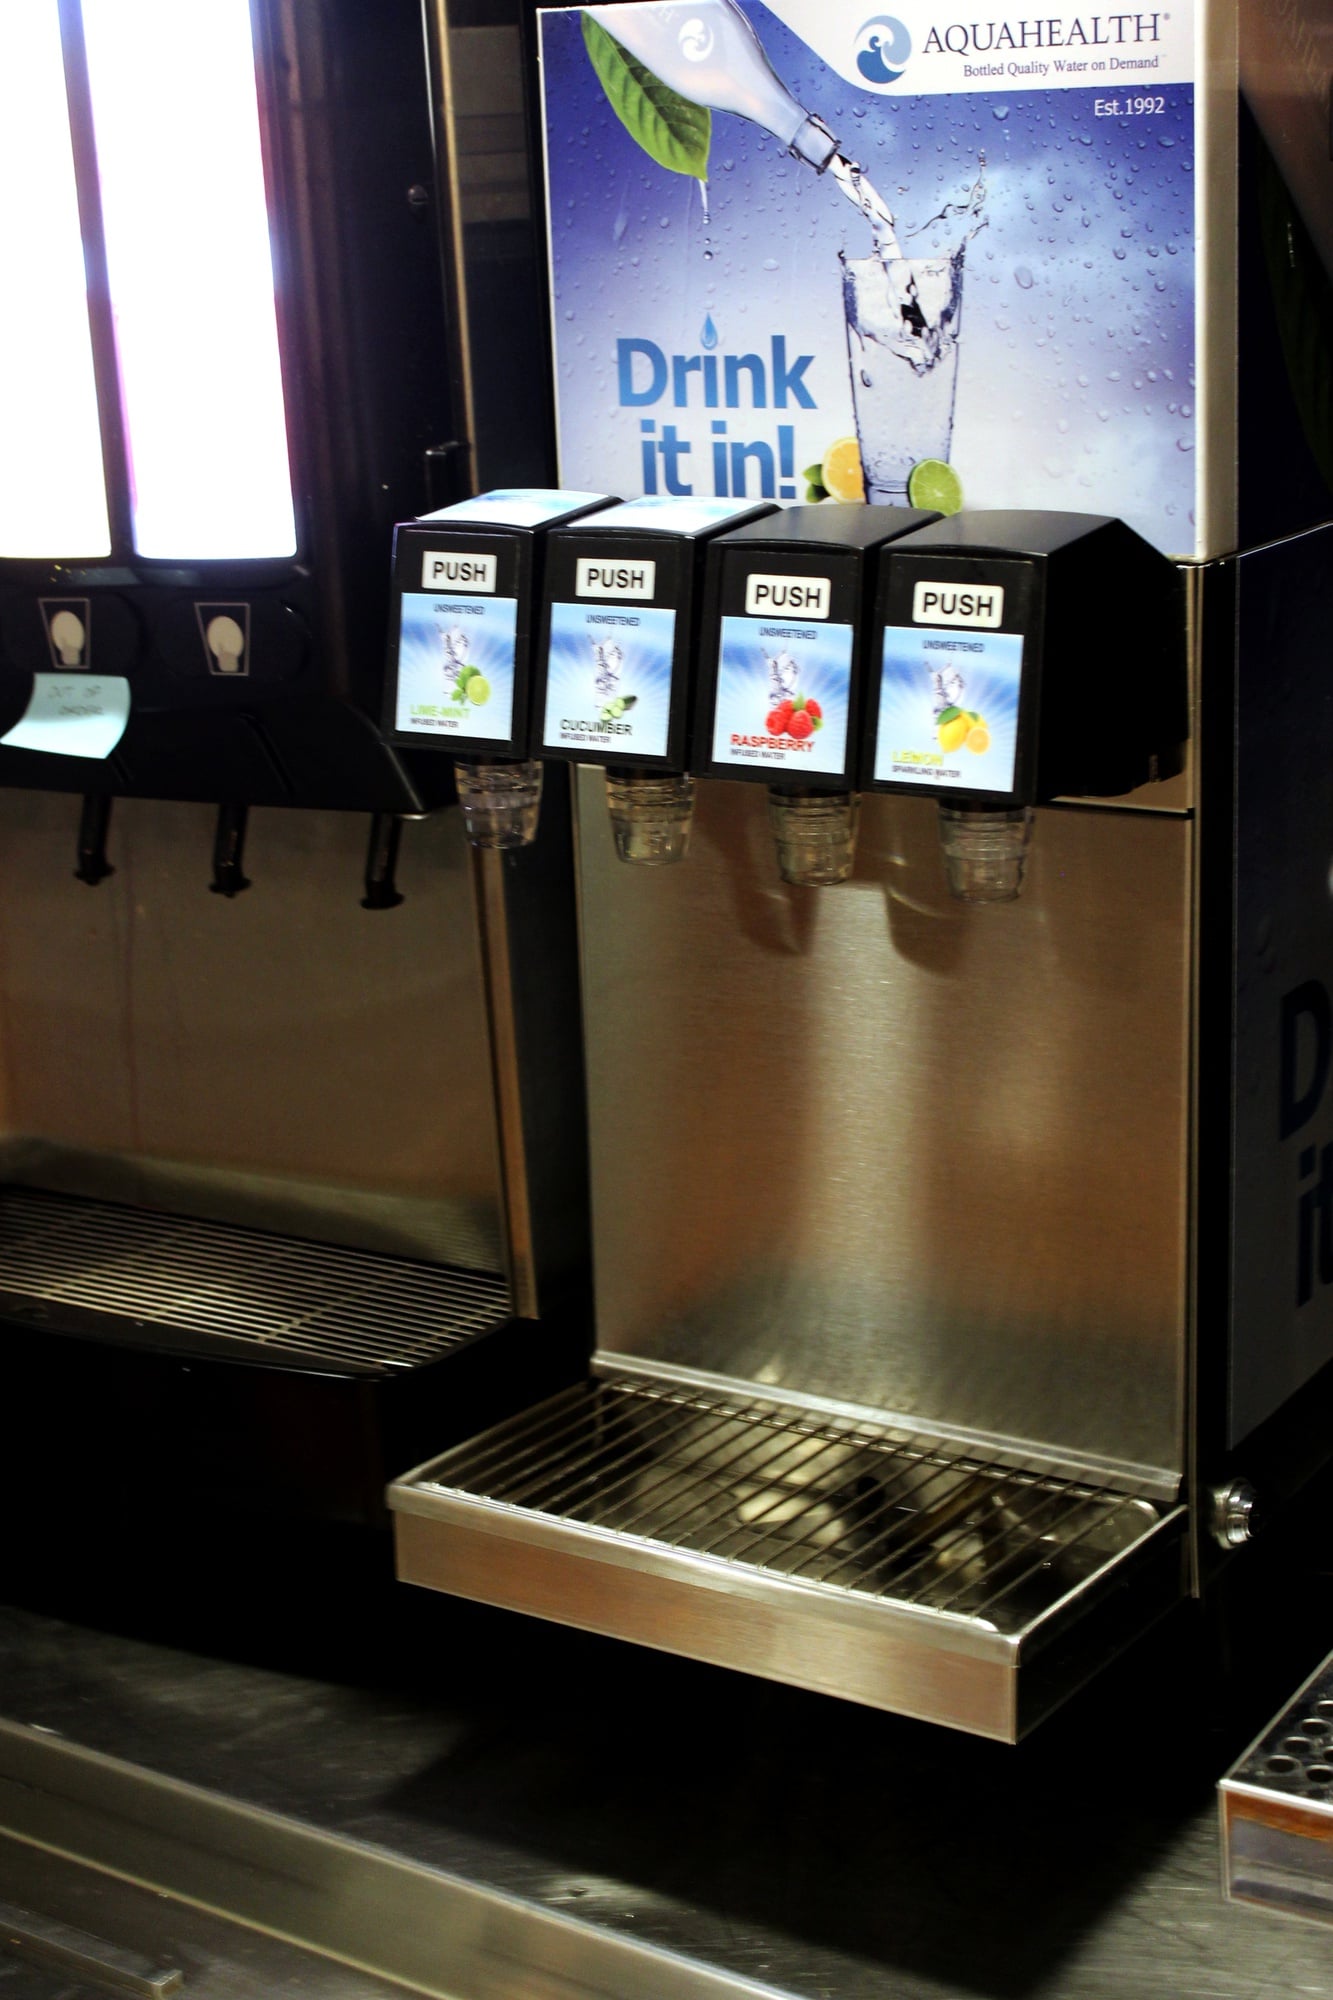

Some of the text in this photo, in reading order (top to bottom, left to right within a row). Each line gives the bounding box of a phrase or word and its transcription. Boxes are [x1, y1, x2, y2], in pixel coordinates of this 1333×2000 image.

[963, 55, 1159, 78] Bottled Quality Water on Demand
[616, 335, 818, 409] Drink
[640, 419, 796, 499] it in!
[432, 561, 487, 582] PUSH
[586, 568, 645, 589] PUSH
[754, 584, 821, 608] PUSH
[922, 592, 994, 617] PUSH
[433, 603, 485, 615] UNSWEETENED
[586, 614, 641, 627] UNSWEETENED
[759, 627, 817, 640] UNSWEETENED
[923, 639, 984, 653] UNSWEETENED
[560, 719, 633, 736] CUCUMBER
[730, 734, 815, 753] RASPBERRY
